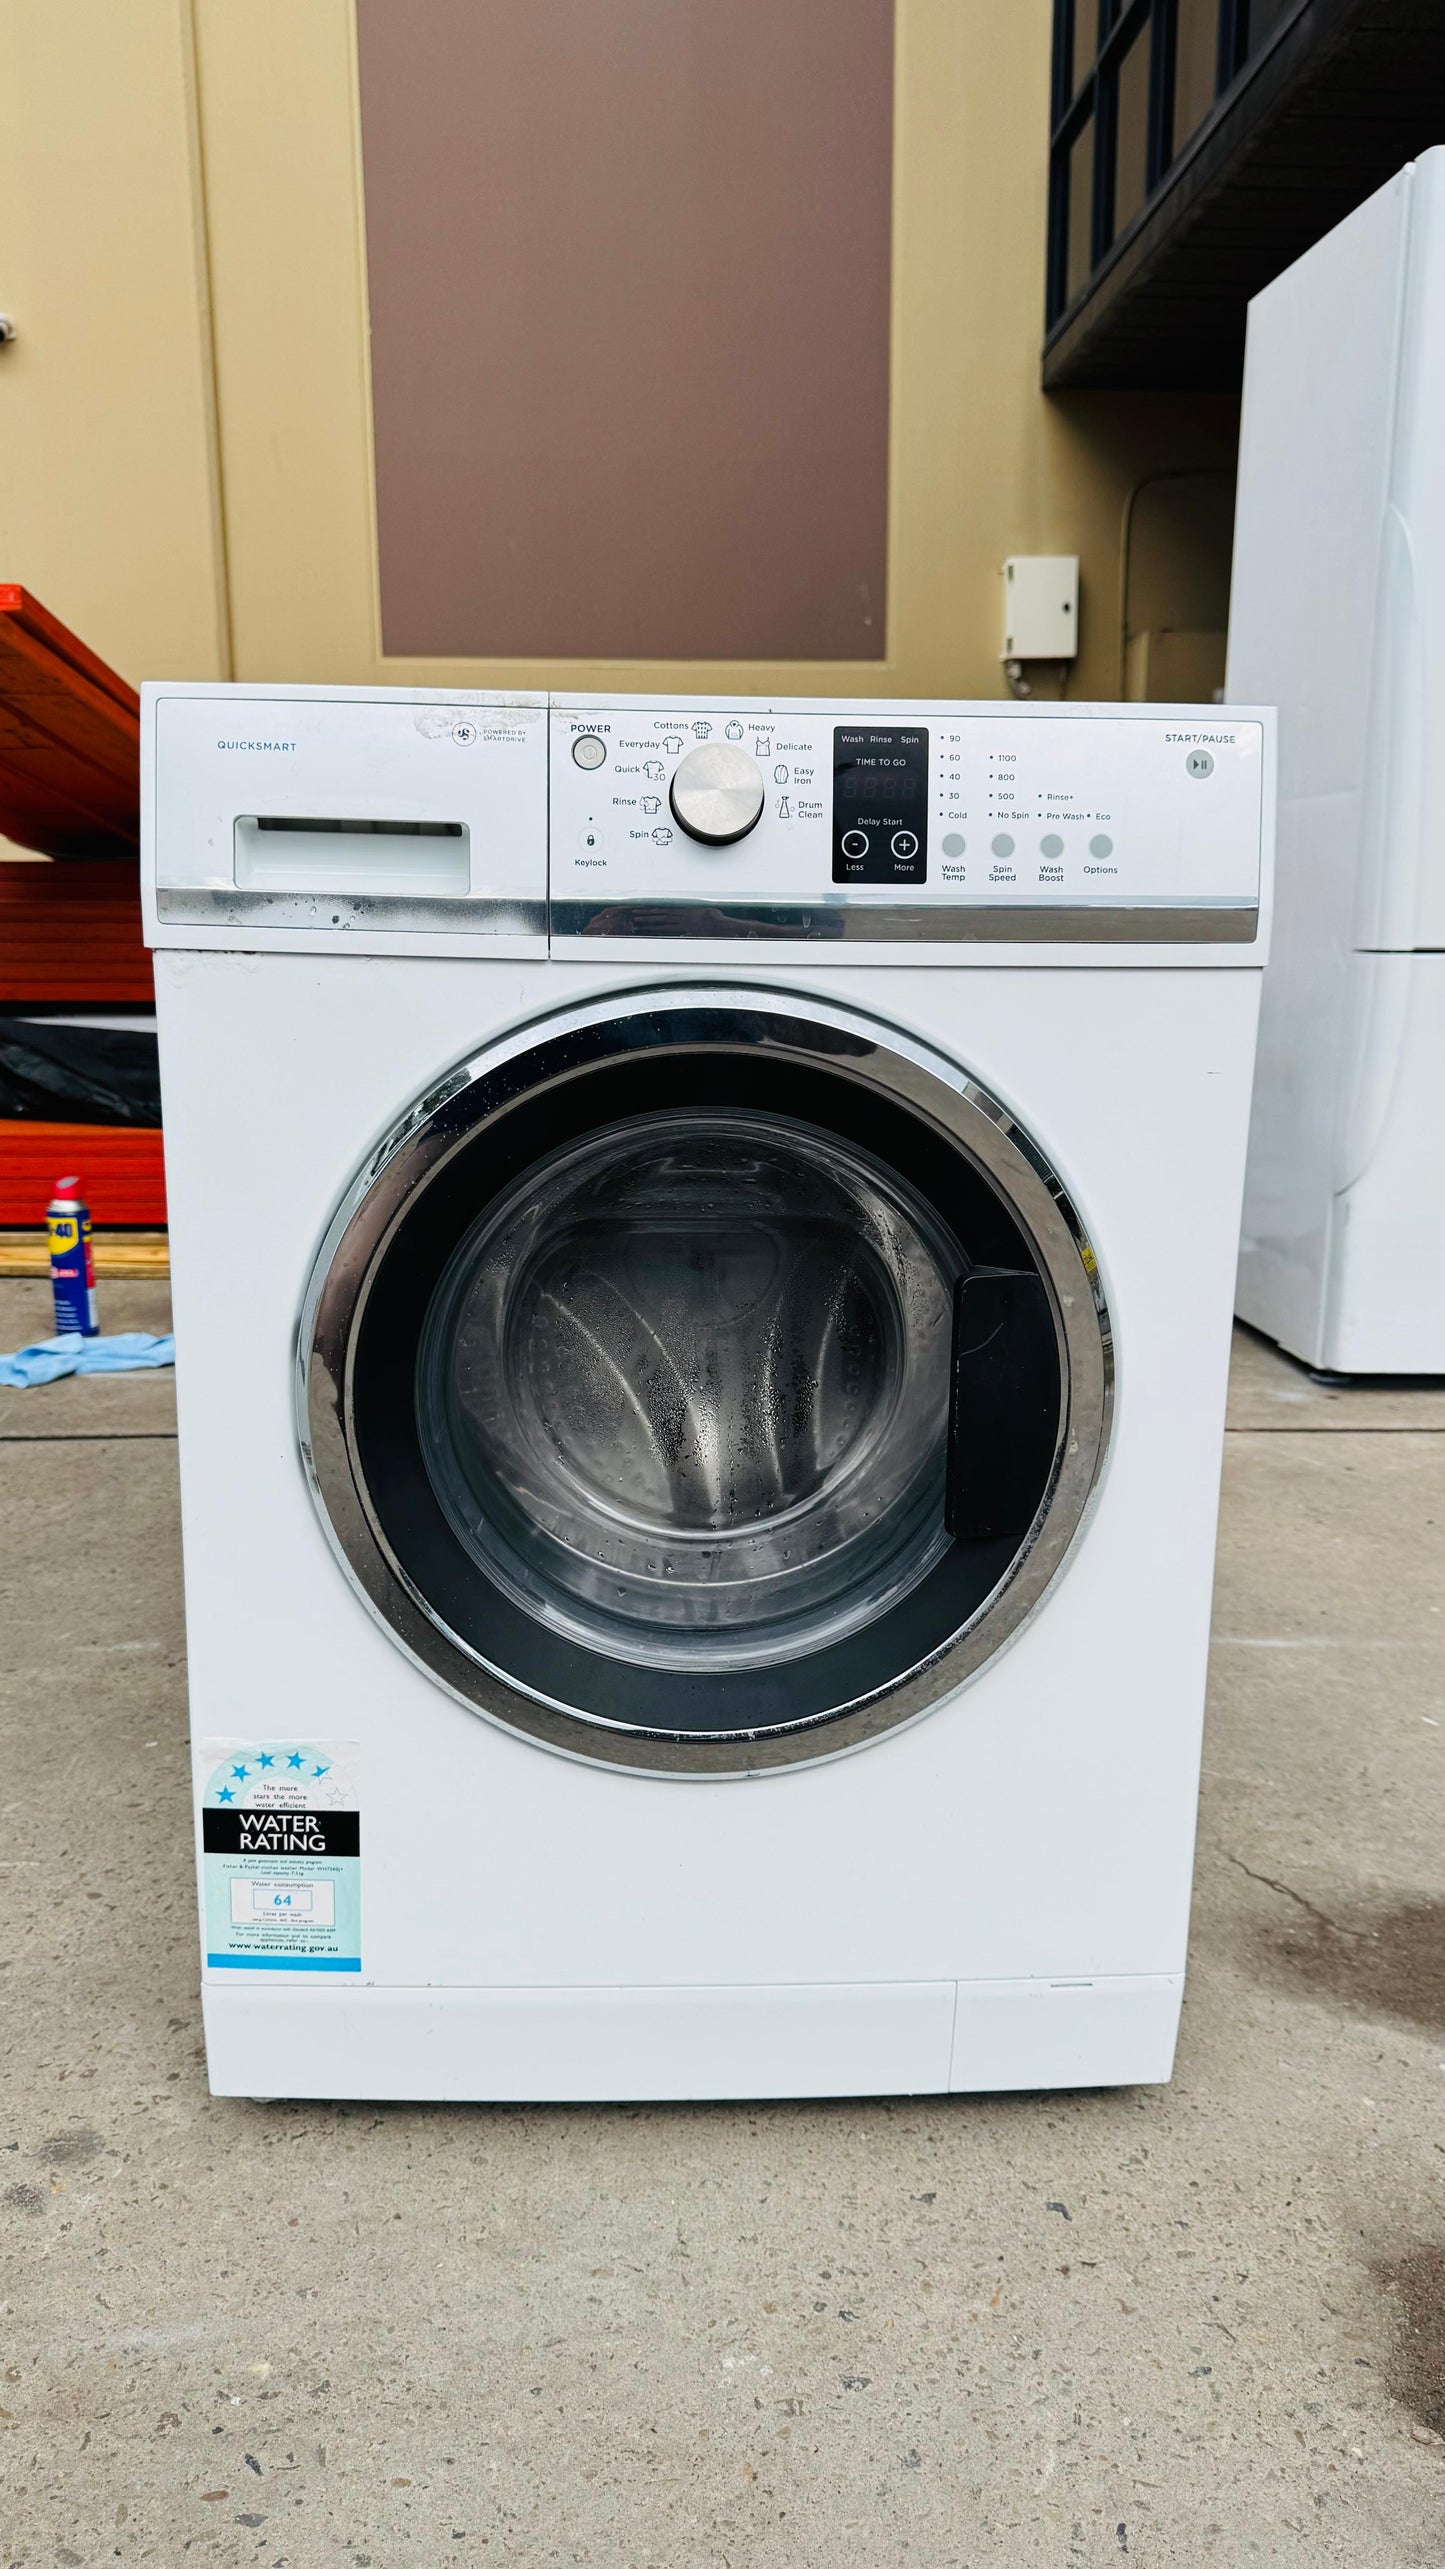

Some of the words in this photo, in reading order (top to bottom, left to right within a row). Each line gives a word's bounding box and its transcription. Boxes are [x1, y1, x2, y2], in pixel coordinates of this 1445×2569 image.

[570, 724, 611, 733] POWER
[654, 722, 689, 730] Cottons
[748, 724, 776, 733] Heavy
[841, 735, 864, 744] Wash
[870, 736, 892, 744] Rinse
[900, 736, 919, 745] Spin
[950, 734, 961, 743] 90
[1165, 734, 1236, 744] START/PAUSE
[217, 740, 297, 752] QUICKSMART
[619, 740, 660, 750] Everyday
[776, 743, 812, 751] Delicate
[856, 758, 876, 766] TIME
[878, 758, 891, 767] TO
[892, 758, 906, 767] GO
[949, 754, 961, 762] 60
[998, 754, 1017, 762] 1100
[614, 765, 640, 774] Quick
[794, 767, 814, 777] Easy
[653, 773, 666, 782] 30
[794, 777, 812, 785] Iron
[949, 772, 961, 781] 40
[998, 774, 1015, 782] 800
[949, 792, 960, 800] 30
[998, 792, 1015, 800] 500
[1047, 793, 1074, 801] Rinse+
[612, 798, 637, 806] Rinse
[798, 801, 823, 809] Drum
[798, 810, 823, 819] Clean
[948, 812, 968, 820] Cold
[998, 812, 1008, 820] No
[1010, 812, 1030, 821] Spin
[1046, 812, 1060, 820] Pre
[1062, 812, 1085, 820] Wash
[1096, 812, 1111, 820] Eco
[858, 818, 880, 827] Delay
[882, 818, 903, 826] Start
[630, 830, 649, 840] Spin
[574, 859, 607, 868] Keylock
[846, 863, 864, 872] Less
[894, 864, 914, 872] More
[942, 865, 966, 873] Wash
[992, 865, 1013, 874] Spin
[1040, 866, 1064, 874] Wash
[1084, 866, 1118, 875] Options
[942, 873, 966, 883] Temp
[988, 874, 1017, 882] Speed
[1038, 874, 1064, 882] Boost
[263, 1784, 276, 1792] The
[239, 1814, 320, 1833] WATER
[240, 1832, 326, 1852] RATING
[274, 1894, 292, 1906] 64
[229, 1942, 339, 1953] www.waterrating.gov.au
